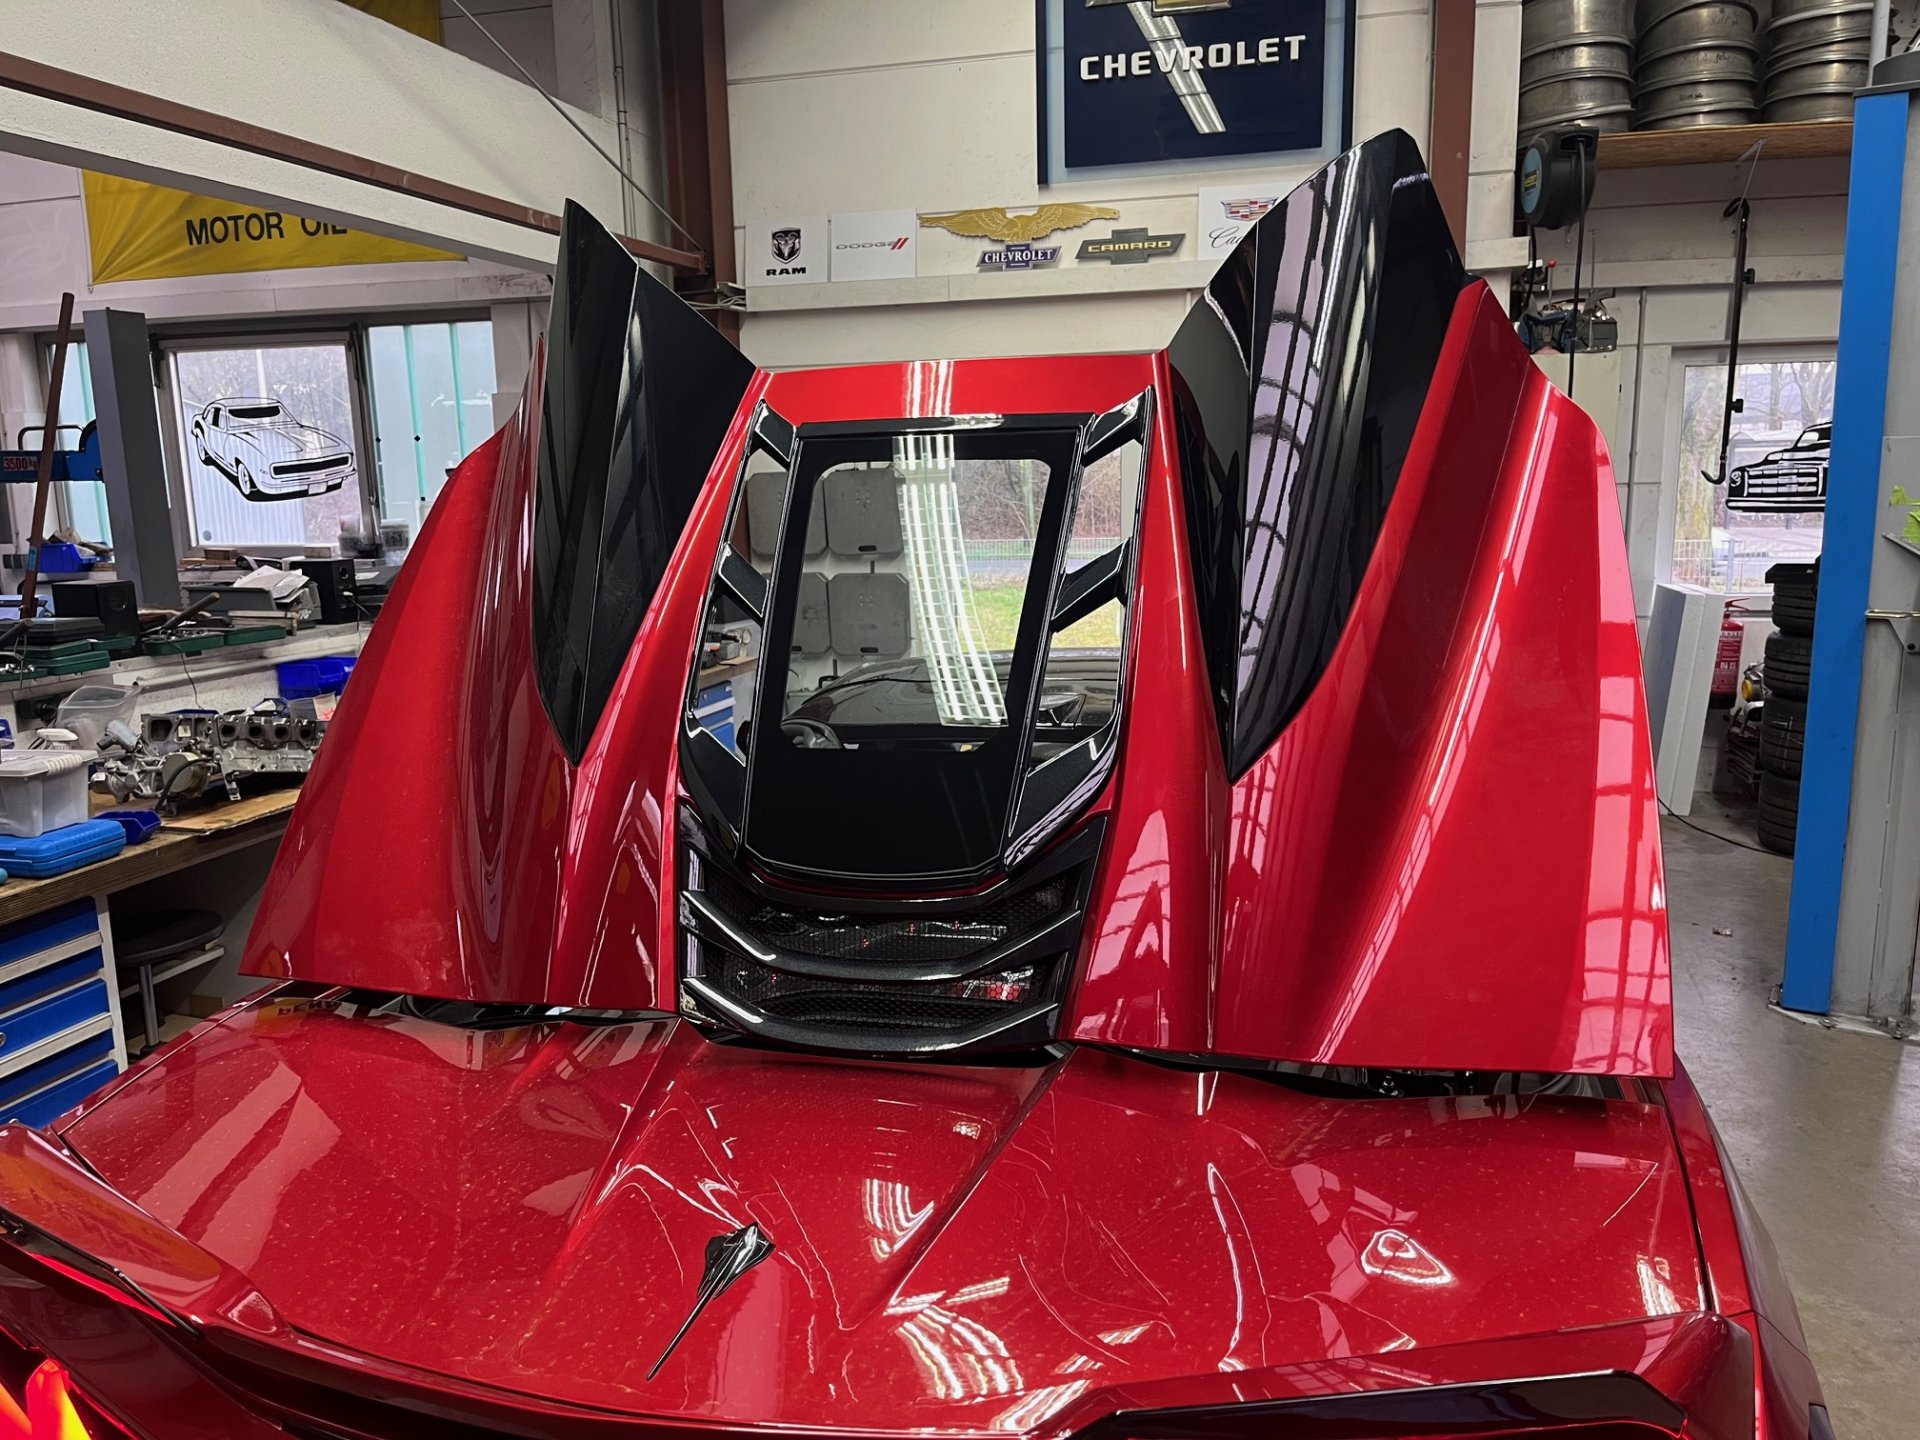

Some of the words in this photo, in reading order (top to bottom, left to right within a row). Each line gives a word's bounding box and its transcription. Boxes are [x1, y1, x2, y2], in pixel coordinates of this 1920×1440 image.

[1080, 35, 1306, 81] CHEVROLET
[186, 212, 285, 246] MOTOR
[1087, 240, 1172, 253] CAMARO
[984, 249, 1053, 264] CHEVROLET
[766, 267, 807, 277] RAM
